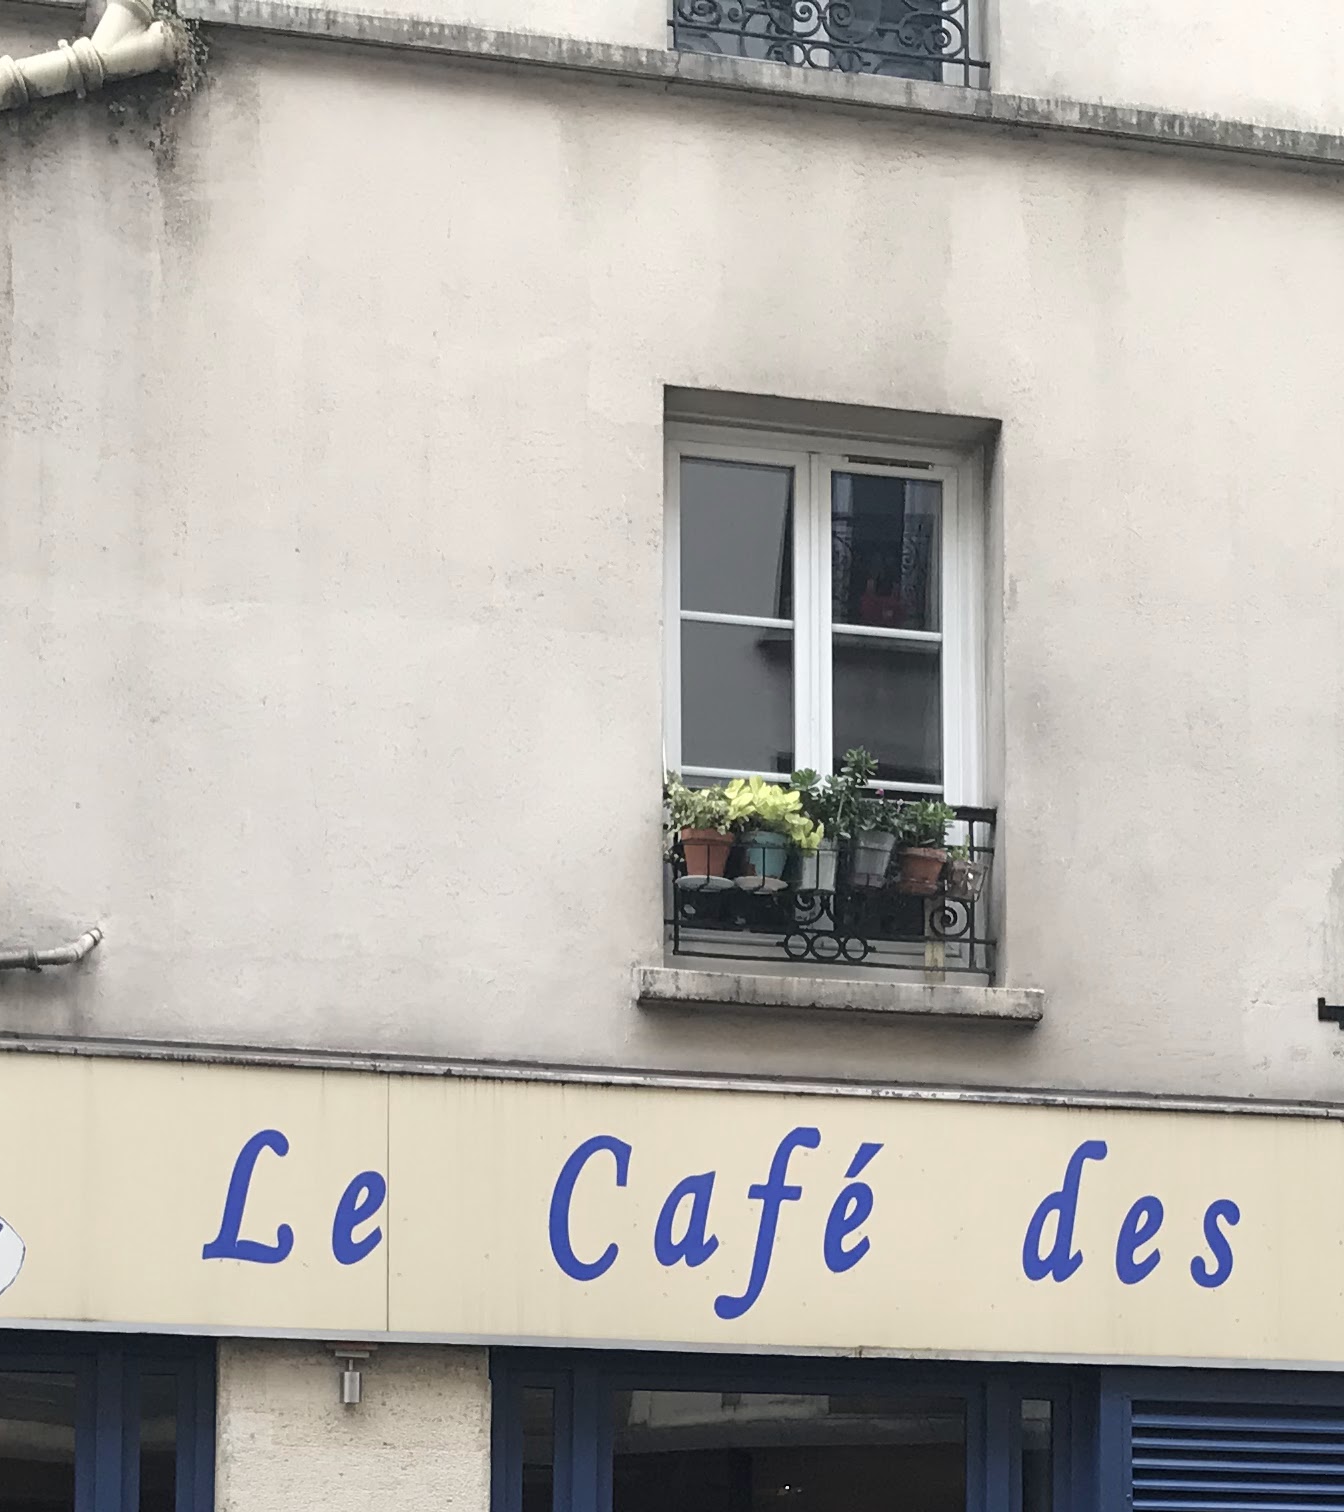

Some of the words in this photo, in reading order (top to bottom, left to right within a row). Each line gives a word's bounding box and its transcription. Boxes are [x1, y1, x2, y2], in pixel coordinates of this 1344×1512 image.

[202, 1129, 387, 1265] Le
[549, 1127, 884, 1320] Café
[1022, 1140, 1240, 1288] des
